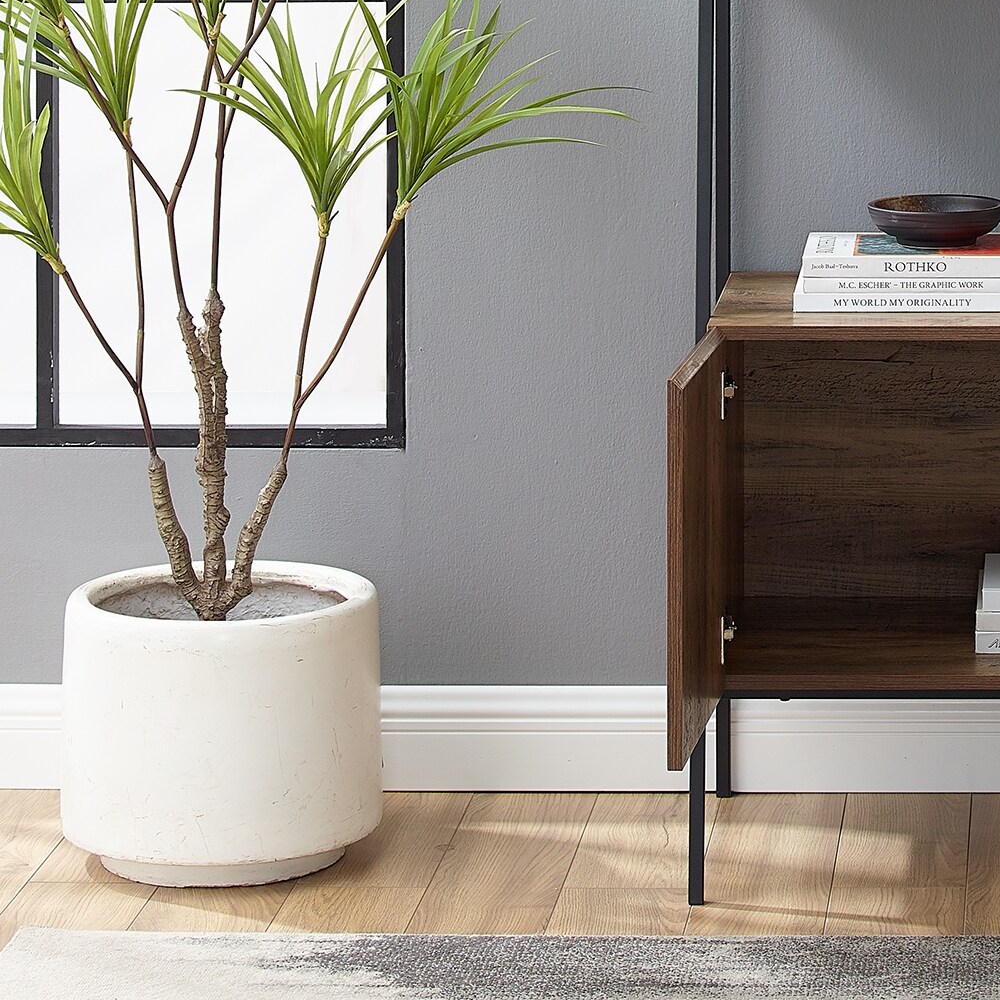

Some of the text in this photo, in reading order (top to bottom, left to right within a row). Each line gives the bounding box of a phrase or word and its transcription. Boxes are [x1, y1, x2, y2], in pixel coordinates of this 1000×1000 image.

[883, 261, 948, 273] ROTHKO
[838, 281, 857, 289] M.C.
[899, 281, 918, 289] THE
[918, 281, 957, 289] GRAPHIC
[958, 281, 984, 289] WORK
[833, 298, 972, 307] MY WORLD MY ORIGINALITY
